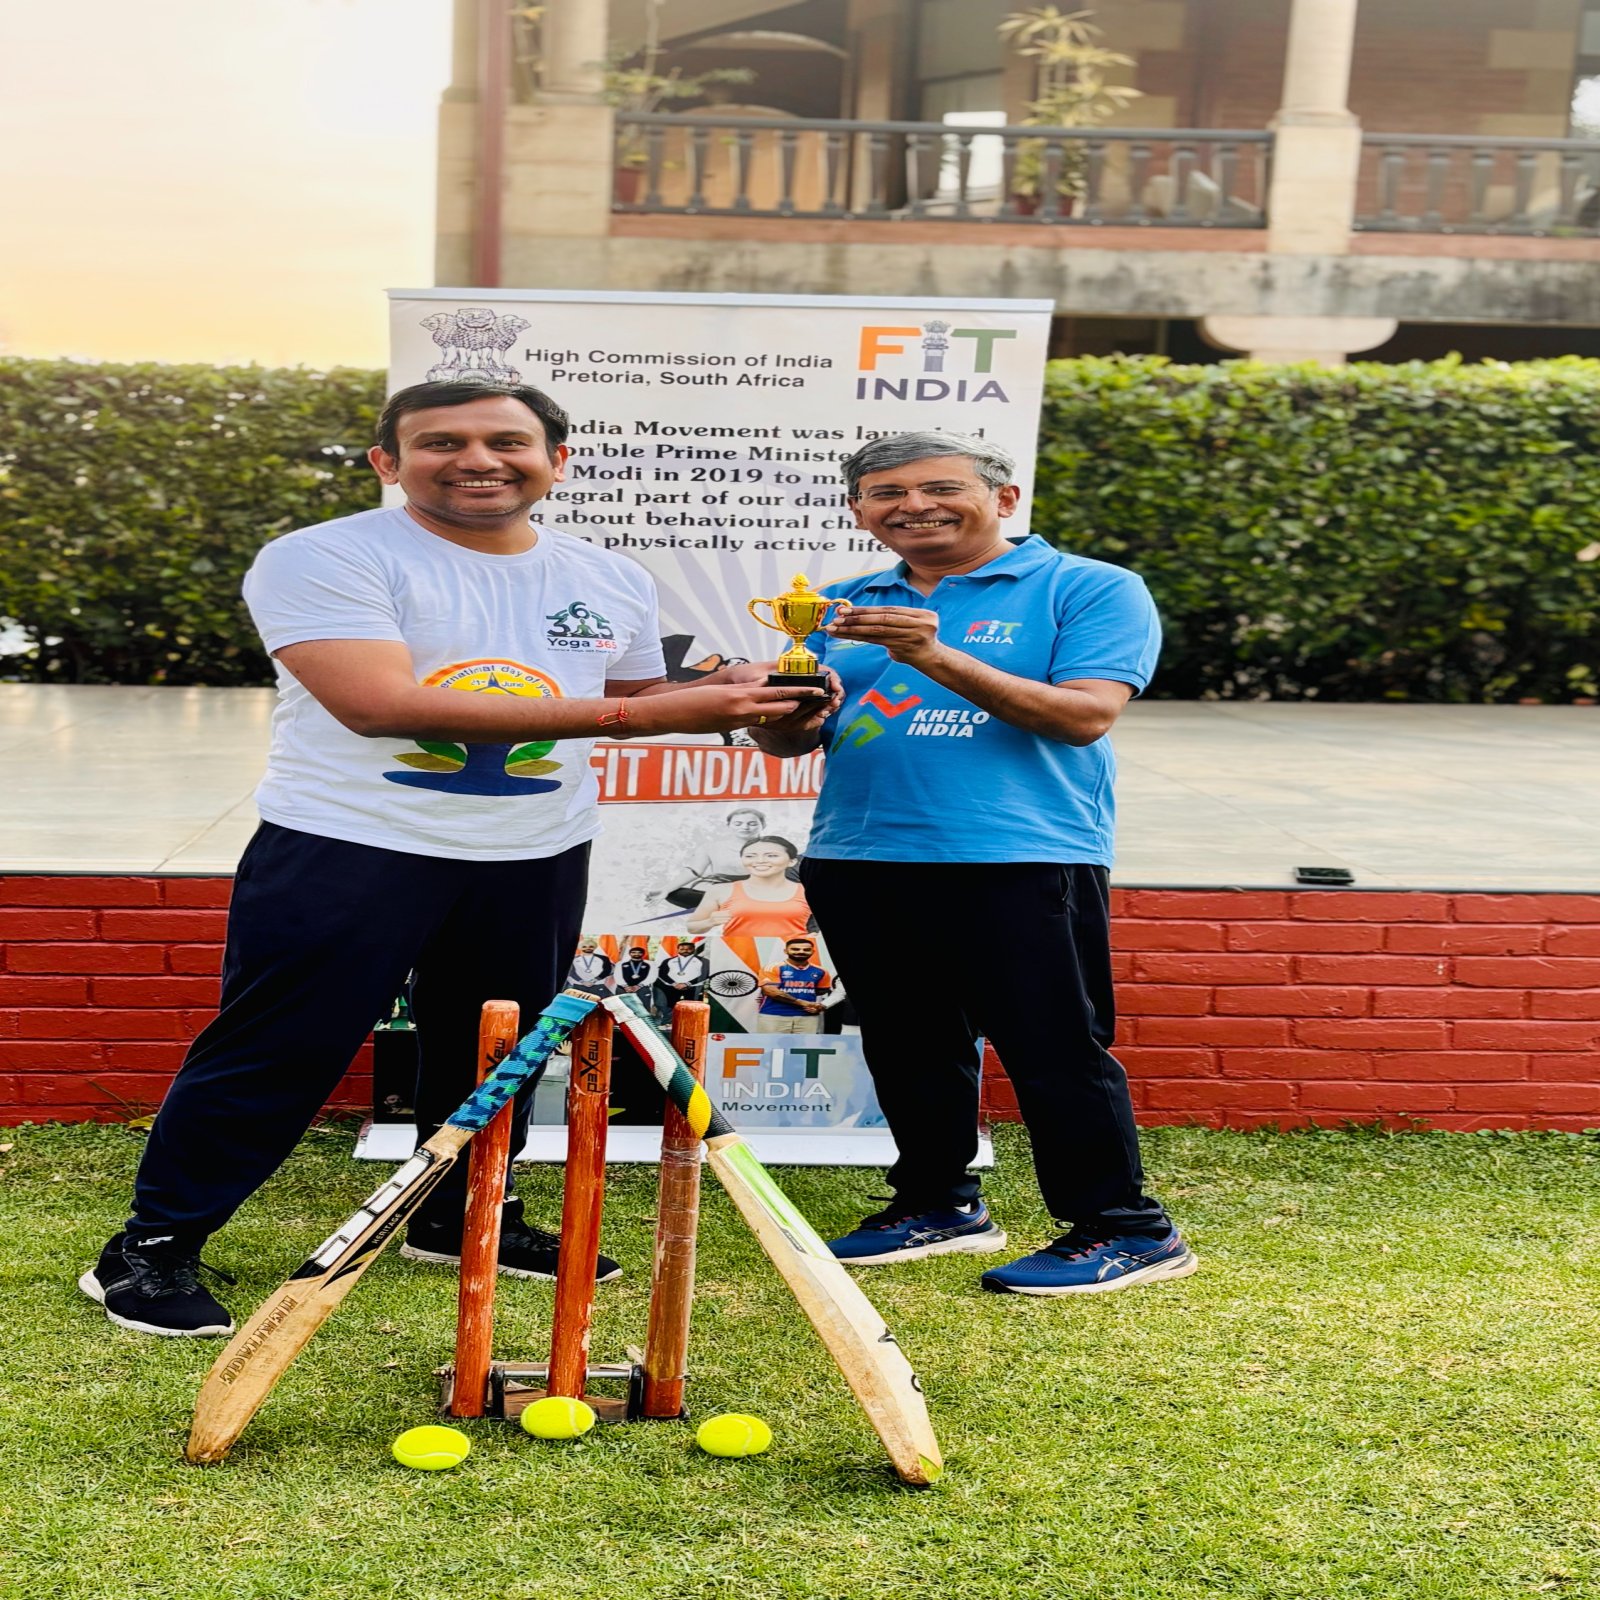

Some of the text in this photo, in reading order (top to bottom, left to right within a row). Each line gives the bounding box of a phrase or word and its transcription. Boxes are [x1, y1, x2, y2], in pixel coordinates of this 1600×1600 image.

[525, 349, 833, 368] High Commission of India
[551, 369, 805, 387] Pretoria, South Africa
[856, 378, 1010, 403] INDIA
[567, 420, 622, 435] ndia
[634, 421, 782, 438] Movement
[791, 428, 845, 440] was
[567, 443, 852, 462] on'ble Prime Ministe
[572, 465, 642, 481] Modi
[654, 467, 679, 482] in
[690, 467, 763, 483] 2019
[774, 471, 801, 485] to
[545, 488, 848, 508] tegral part of our dail
[555, 510, 635, 525] about
[646, 511, 809, 529] behavioural
[604, 533, 744, 552] physically
[754, 539, 837, 551] active
[547, 638, 617, 650] Yoga 365
[963, 635, 1015, 645] INDIA
[500, 666, 523, 678] day
[525, 675, 541, 684] of
[912, 709, 990, 725] KHELO
[906, 723, 974, 738] INDIA
[660, 749, 769, 797] INDIA
[722, 1047, 837, 1079] FIT
[722, 1082, 833, 1099] INDIA
[722, 1101, 832, 1112] Movement
[372, 1213, 403, 1244] HERITAGE
[219, 1295, 299, 1386] HERITAGE
